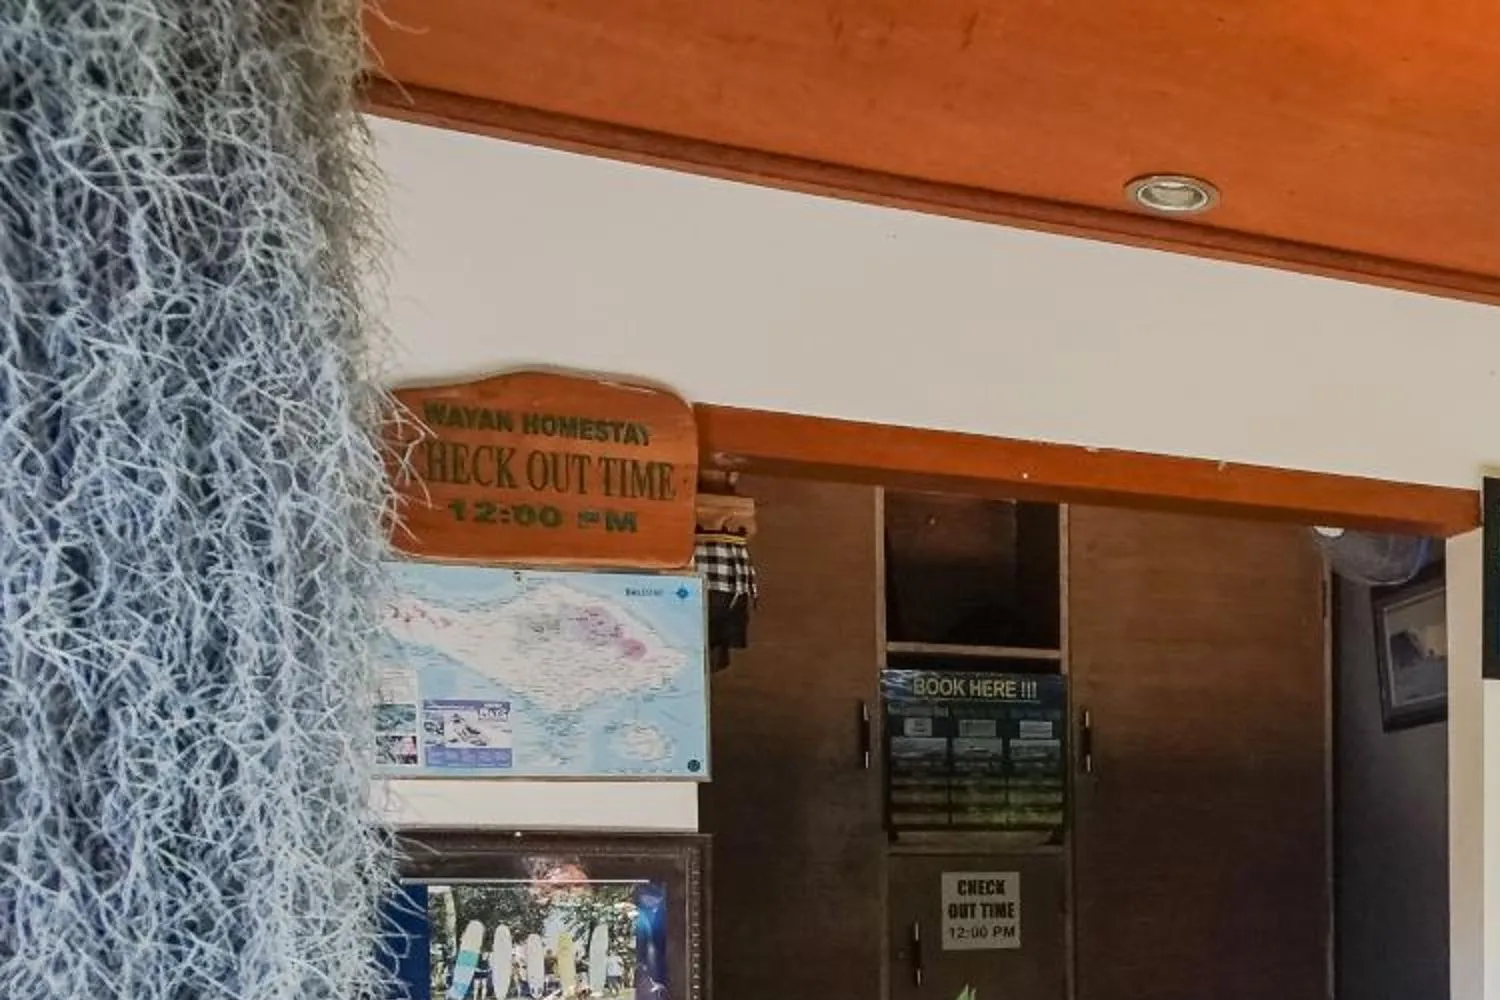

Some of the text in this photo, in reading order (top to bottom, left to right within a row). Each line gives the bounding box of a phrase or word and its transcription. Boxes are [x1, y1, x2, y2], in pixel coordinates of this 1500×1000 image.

[423, 402, 651, 446] WAYAN HOMESTAY
[526, 449, 590, 494] OUT
[599, 456, 676, 501] TIME
[448, 501, 638, 533] 12:00 PM
[913, 677, 965, 696] BOOK
[969, 679, 1017, 698] HERE
[957, 879, 1006, 896] CHECK
[948, 901, 1015, 919] OUT TIME
[993, 925, 1015, 937] PM
